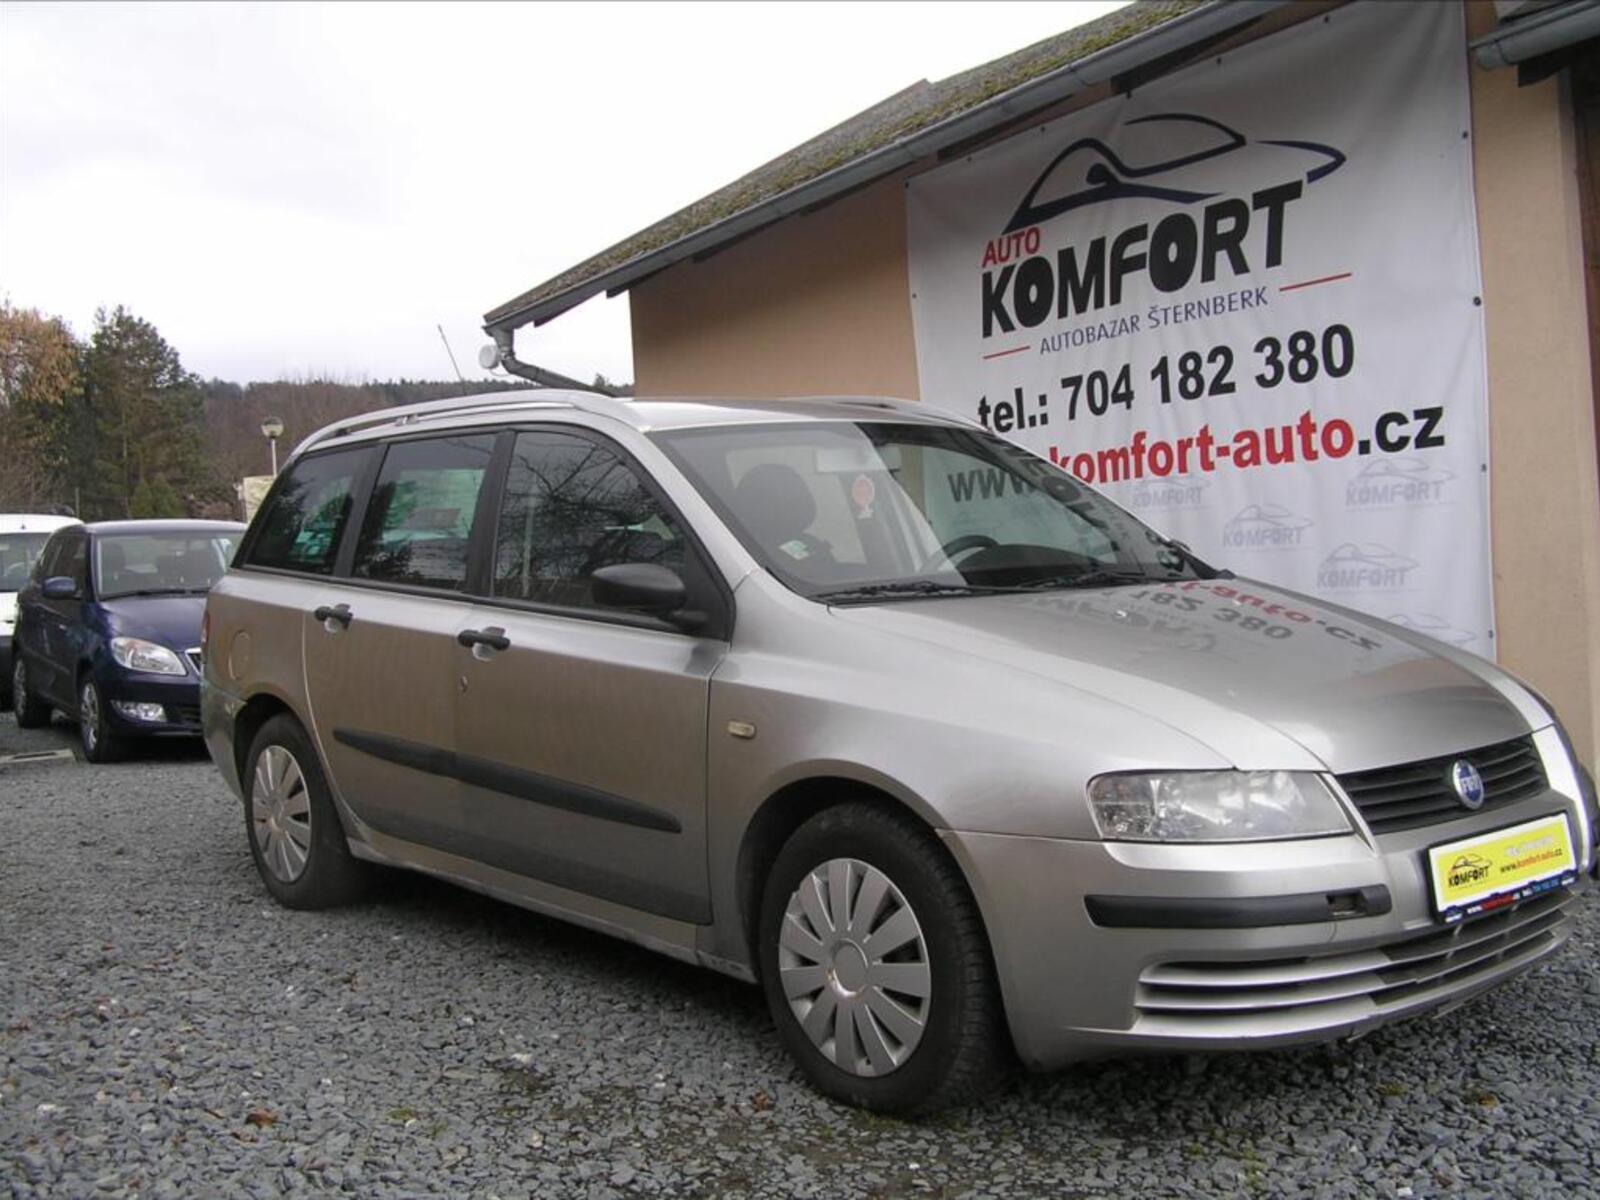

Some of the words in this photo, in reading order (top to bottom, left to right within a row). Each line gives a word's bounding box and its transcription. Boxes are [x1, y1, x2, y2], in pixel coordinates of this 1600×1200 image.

[982, 227, 1040, 268] AUTO
[982, 180, 1303, 338] KOMFORT
[1040, 315, 1140, 354] AUTOBAZAR
[1148, 286, 1268, 330] ŠTERNBERK
[978, 388, 1048, 434] tel.:
[1061, 364, 1134, 420] 704
[1150, 346, 1236, 404] 182
[1253, 324, 1355, 389] 380
[1344, 480, 1445, 507] KOMFORT
[1316, 567, 1409, 588] KOMFORT
[1448, 866, 1490, 888] KOMFORT
